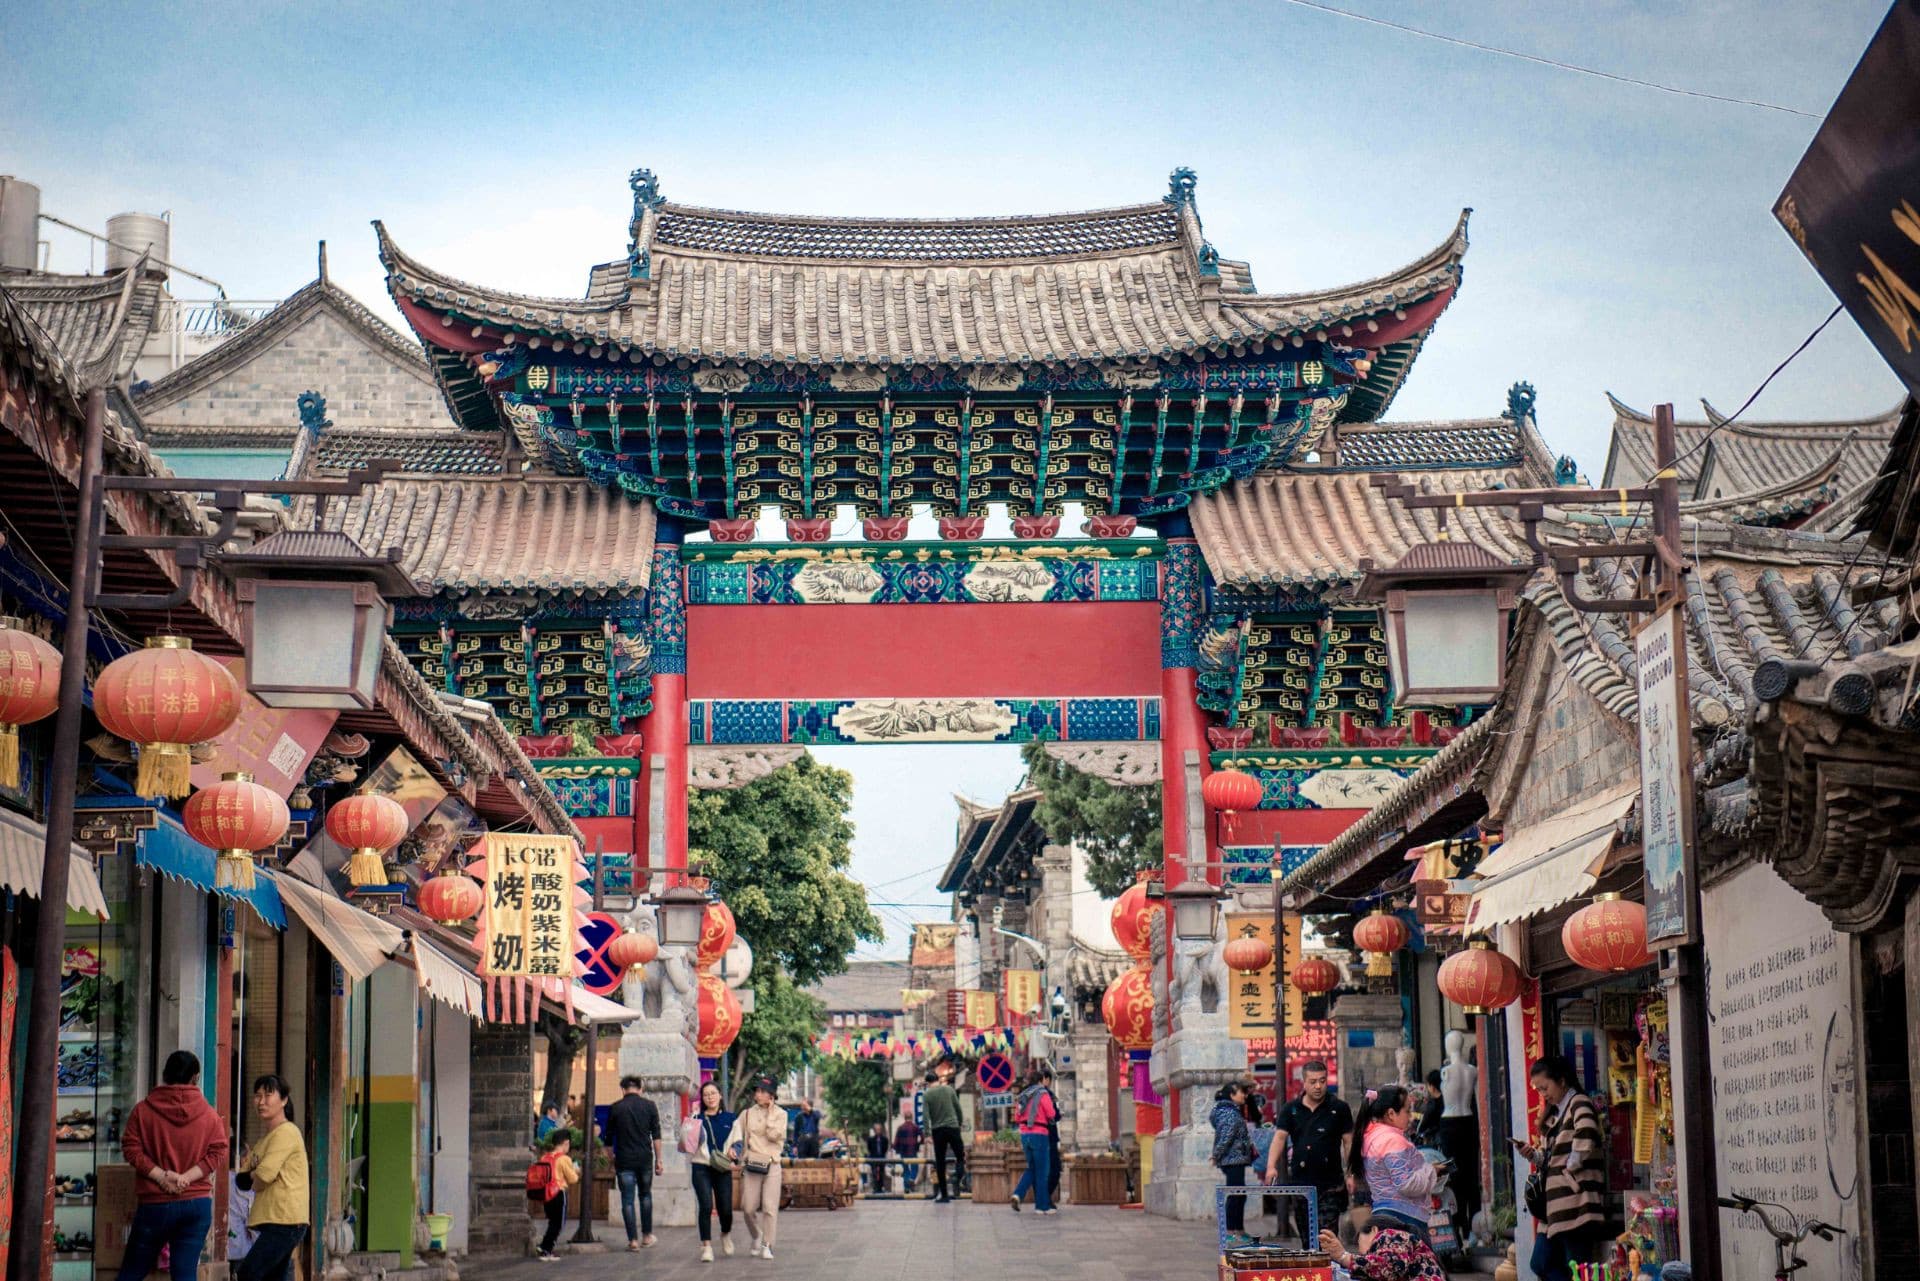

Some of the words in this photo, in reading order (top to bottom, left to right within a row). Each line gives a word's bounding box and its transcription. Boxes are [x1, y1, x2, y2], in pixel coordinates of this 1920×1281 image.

[493, 872, 525, 971] 烤奶
[529, 873, 563, 974] 酸奶紫米露
